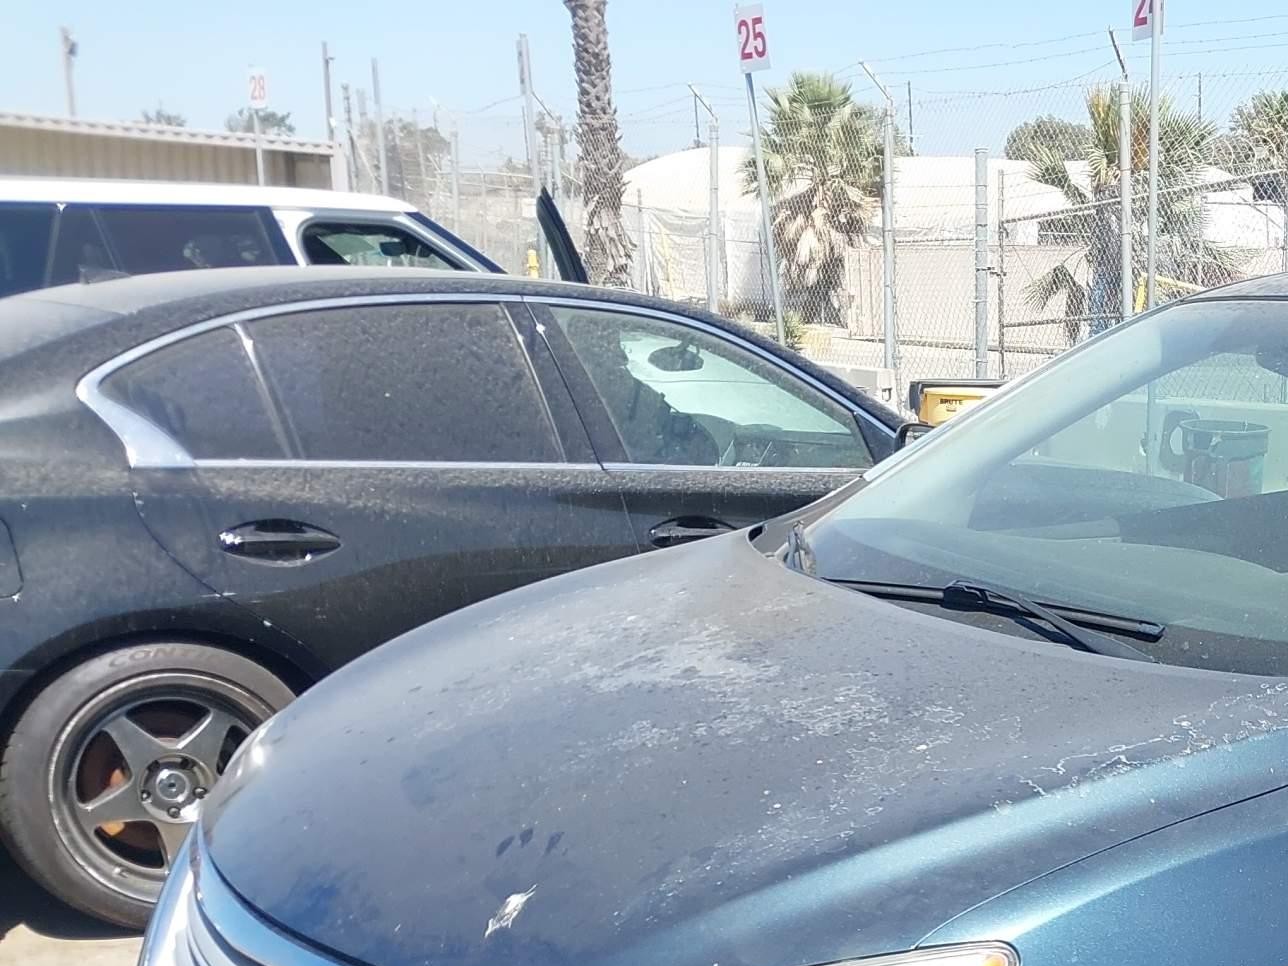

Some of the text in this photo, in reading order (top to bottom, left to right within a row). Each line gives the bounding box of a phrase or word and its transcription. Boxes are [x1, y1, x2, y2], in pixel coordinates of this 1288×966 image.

[738, 16, 767, 61] 25
[249, 74, 266, 101] 28
[939, 398, 964, 406] BRUTE
